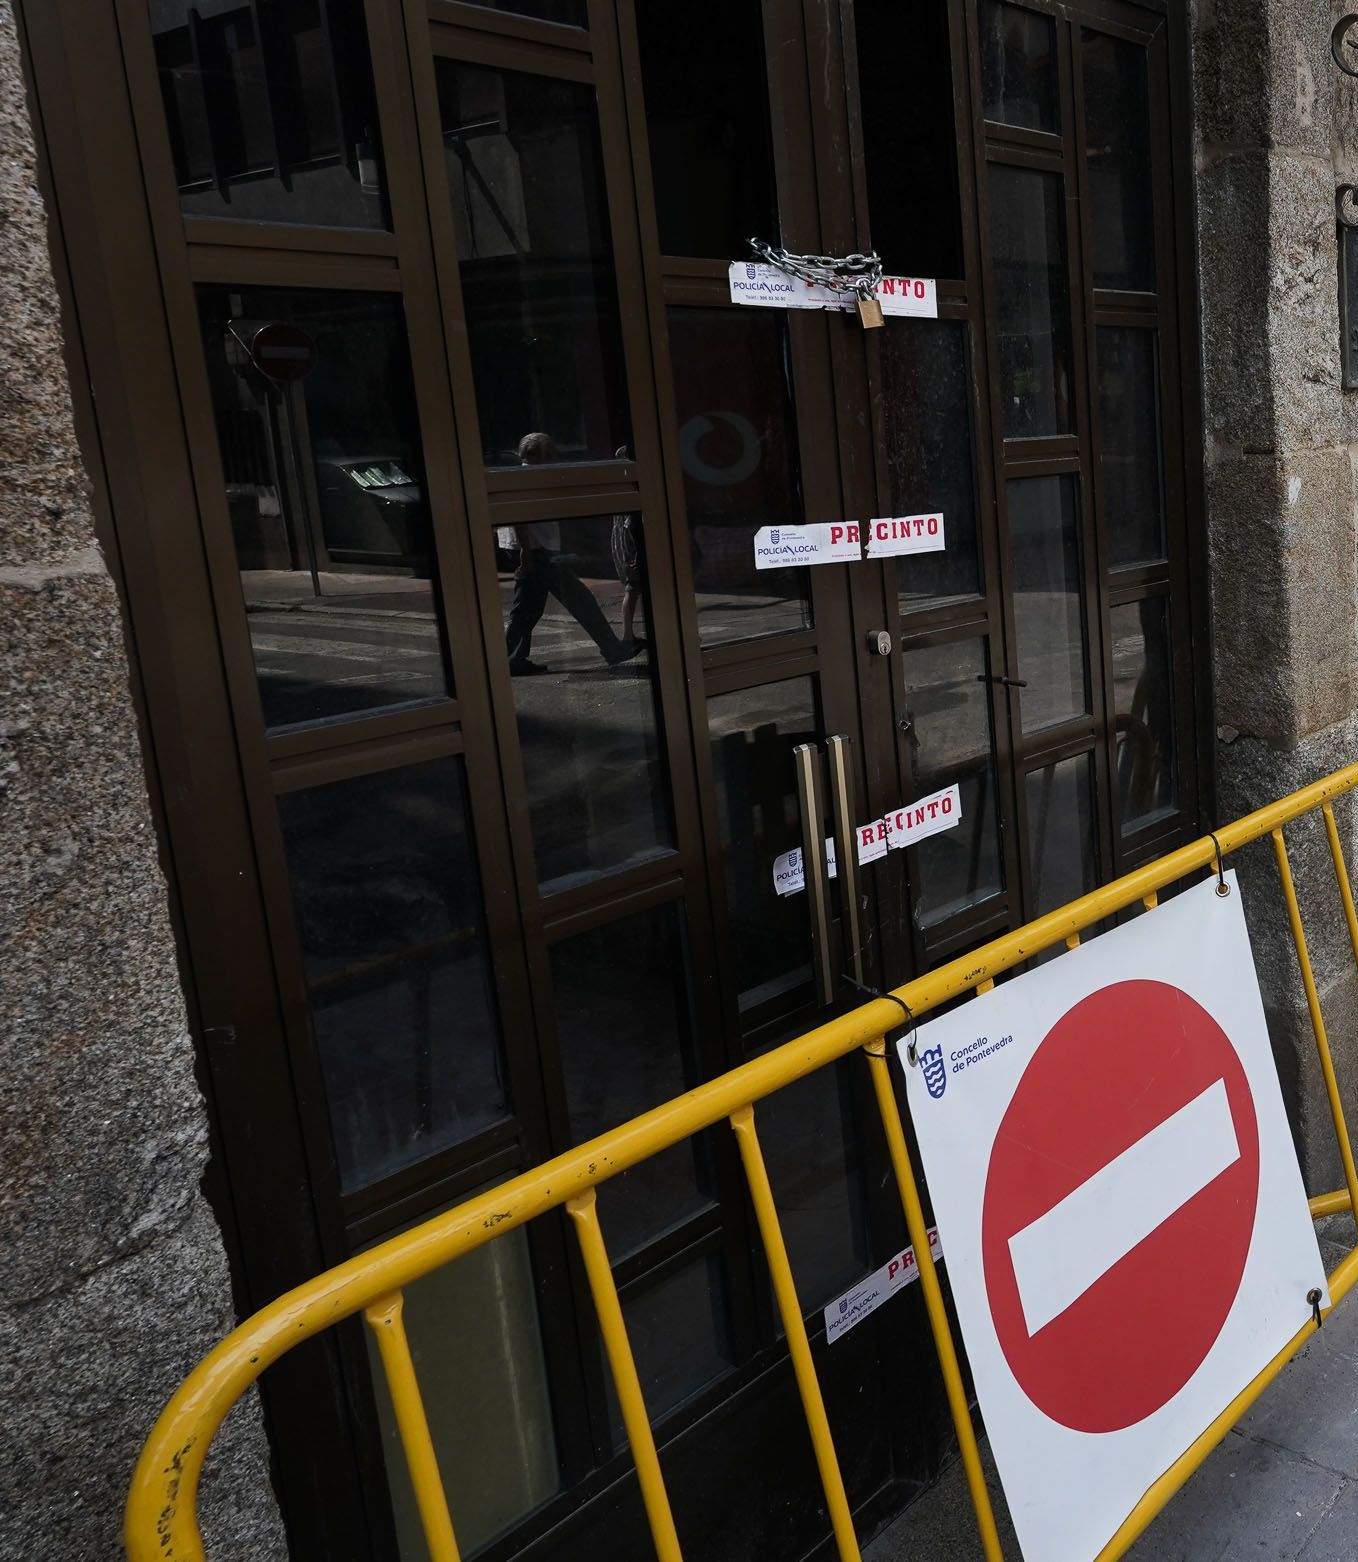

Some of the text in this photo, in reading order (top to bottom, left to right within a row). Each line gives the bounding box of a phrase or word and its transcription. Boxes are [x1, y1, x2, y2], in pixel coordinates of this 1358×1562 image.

[770, 283, 795, 293] LOCAL
[830, 518, 938, 545] PRCINTO
[794, 544, 819, 553] LOCAL
[860, 797, 953, 847] RECINTO
[950, 1036, 988, 1062] Concello
[952, 1035, 1014, 1074] de Pontevedra
[859, 1291, 880, 1308] LOCAL
